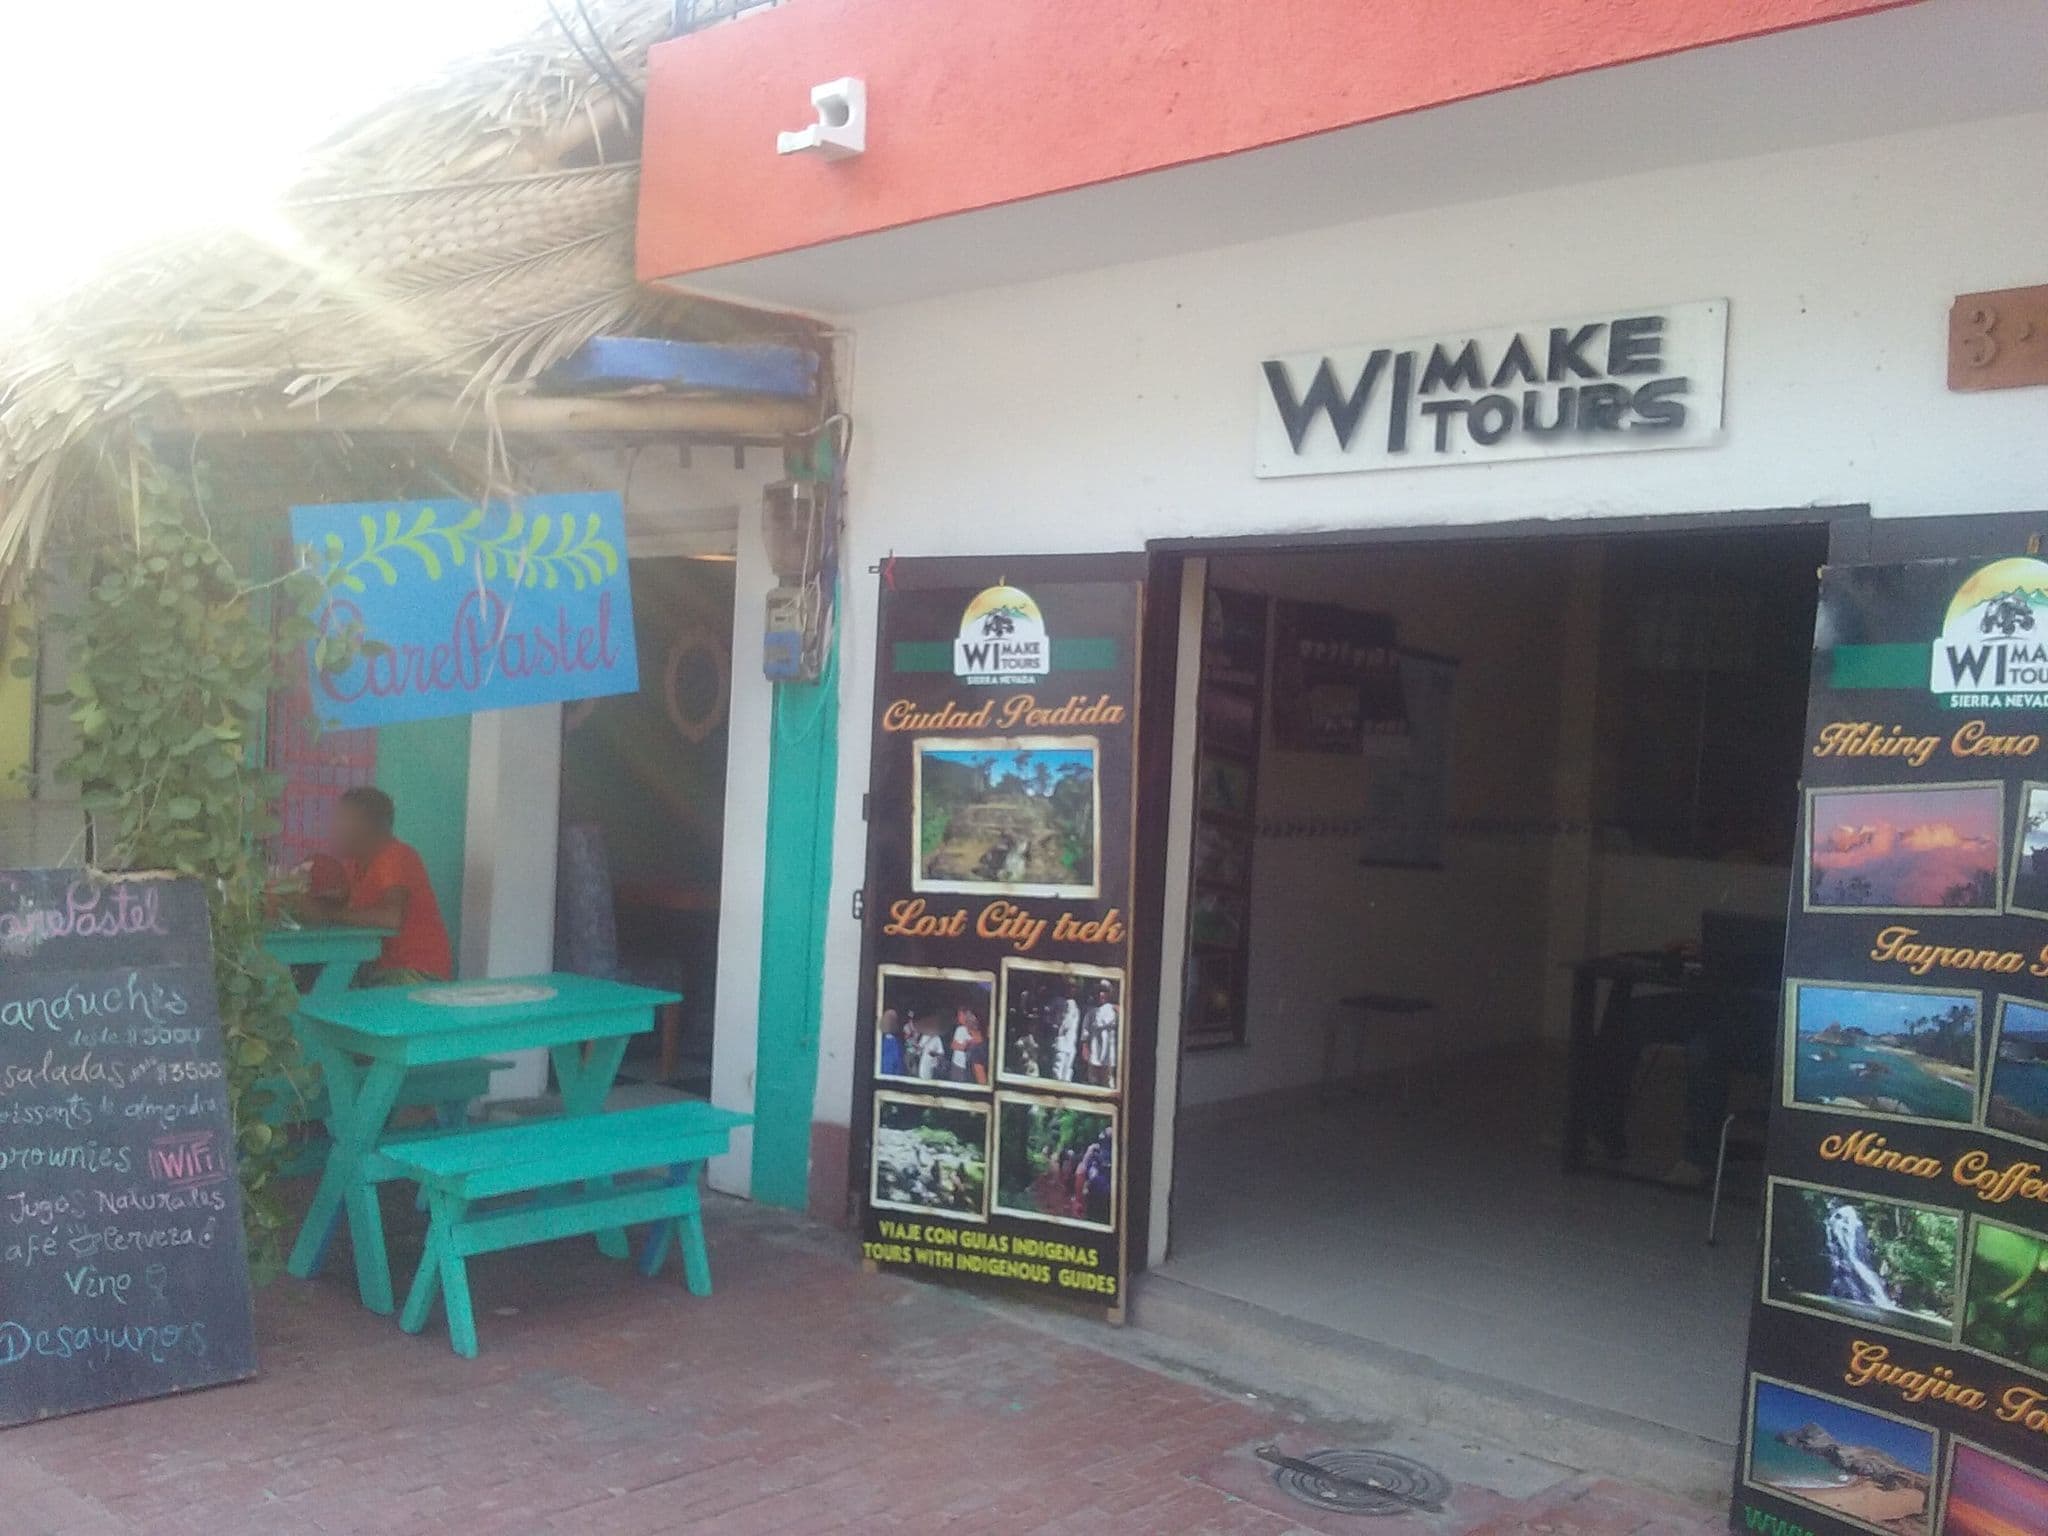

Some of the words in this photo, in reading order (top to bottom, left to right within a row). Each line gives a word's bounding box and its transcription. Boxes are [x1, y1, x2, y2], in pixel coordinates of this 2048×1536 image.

[1261, 349, 1415, 454] WI
[1418, 316, 1666, 394] MAKE
[1421, 376, 1689, 453] TOURS
[963, 643, 999, 671] WI
[1002, 642, 1040, 655] MAKE
[1001, 658, 1040, 669] TOURS
[1947, 644, 2006, 687] WI
[883, 699, 995, 731] Ciudad
[996, 694, 1126, 729] Perdida
[1950, 694, 2001, 708] SIERRA
[1812, 720, 1941, 768] Hiking
[884, 898, 968, 937] Lost
[976, 900, 1047, 951] City
[1052, 908, 1125, 943] trek
[1871, 926, 2026, 975] Tayrona
[1819, 1130, 1943, 1178] Minca
[879, 1220, 921, 1241] VIAJE
[924, 1226, 957, 1246] CON
[960, 1231, 1008, 1252] GUIAS
[1012, 1237, 1098, 1267] INDIGENAS
[65, 1264, 132, 1305] Vino
[863, 1242, 911, 1263] TOURS
[914, 1247, 953, 1269] WITH
[957, 1254, 1050, 1283] INDIGENOUS
[1058, 1268, 1116, 1295] GUIDES
[1844, 1340, 1987, 1410] Guajira
